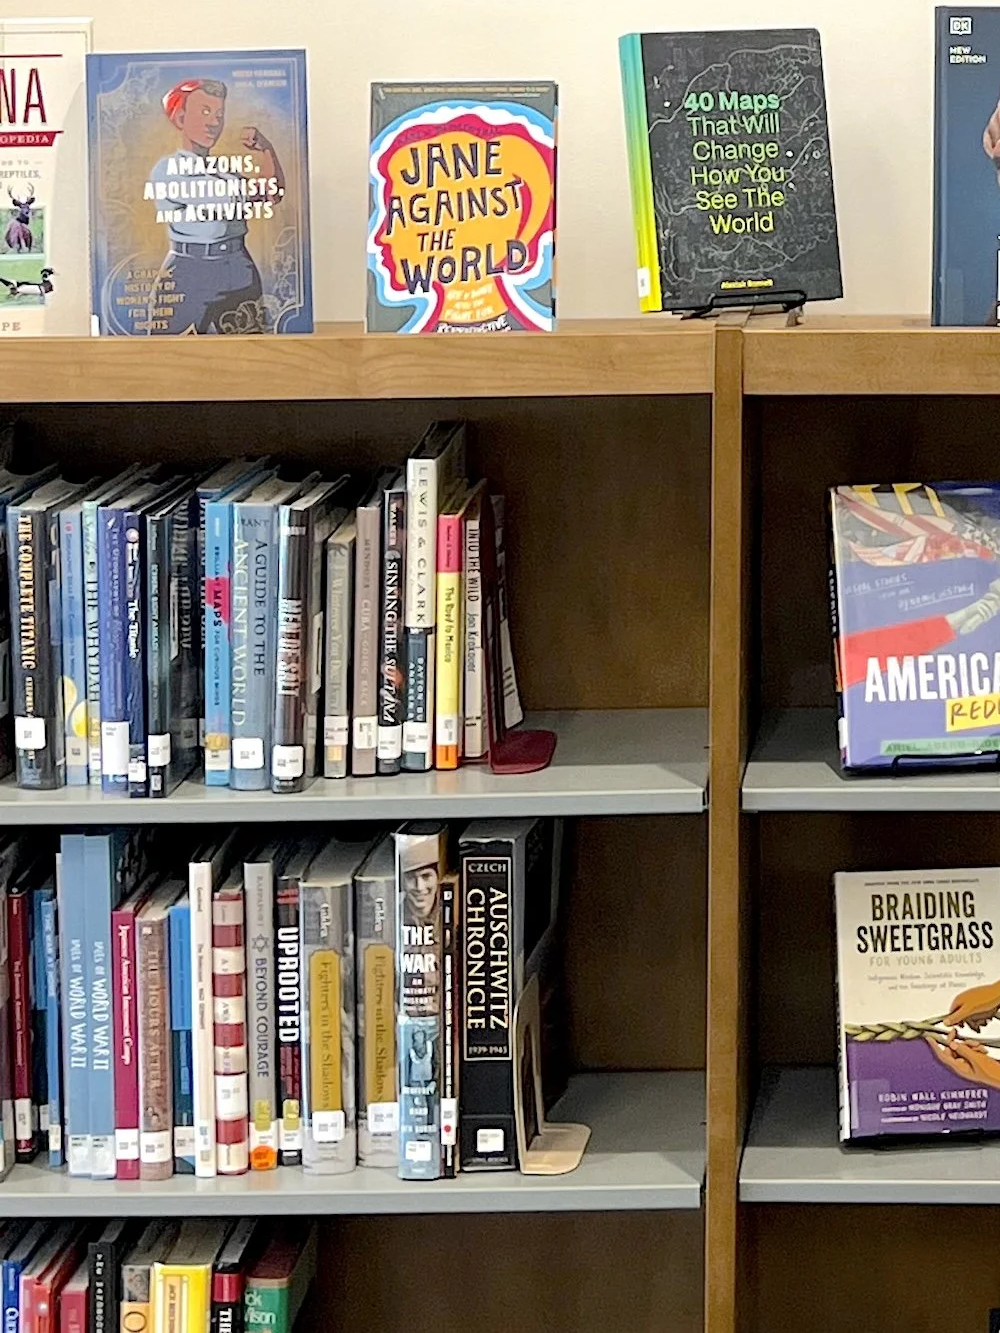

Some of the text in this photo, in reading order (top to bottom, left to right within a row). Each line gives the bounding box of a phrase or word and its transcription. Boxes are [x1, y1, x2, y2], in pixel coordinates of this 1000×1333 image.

[952, 20, 969, 31] DK
[950, 54, 986, 63] EDITION
[684, 91, 781, 115] 40 Maps
[687, 114, 780, 136] That Will
[400, 141, 502, 189] JANE
[692, 140, 779, 164] Change
[690, 164, 785, 185] How You
[156, 201, 273, 223] AND ACTIVISTS
[387, 178, 523, 235] AGAINST
[695, 188, 784, 210] See The
[709, 211, 774, 234] World
[417, 228, 456, 252] THE
[400, 239, 527, 295] WORLD
[416, 466, 428, 624] LEWIS & CLARK
[468, 527, 479, 602] INTO THE WILD
[17, 515, 37, 670] THE COMPLETE TITANIC
[254, 539, 267, 676] A GUIDE TO THE
[384, 561, 400, 623] SINKING
[86, 579, 100, 703] THE WHYDAH
[128, 599, 139, 659] The Titanic
[232, 537, 249, 727] ANCIENT WORLD
[384, 626, 398, 654] THE
[467, 863, 507, 874] CZECH
[871, 891, 976, 922] BRAIDING
[402, 925, 434, 946] THE
[857, 921, 994, 954] SWEETGRASS
[401, 952, 436, 974] WAR
[466, 888, 485, 1029] CHRONICLE
[488, 887, 508, 1029] AUSCHWITZ
[869, 952, 983, 967] FOR YOUNG ADULTS
[278, 927, 300, 1043] UPROOTED
[321, 961, 333, 1007] Fighters
[69, 977, 86, 1068] WORLD WAR II
[92, 978, 109, 1070] WORLD WAR II
[255, 958, 268, 1078] BEYOND COURAGE
[322, 1011, 332, 1024] in
[322, 1029, 333, 1048] the
